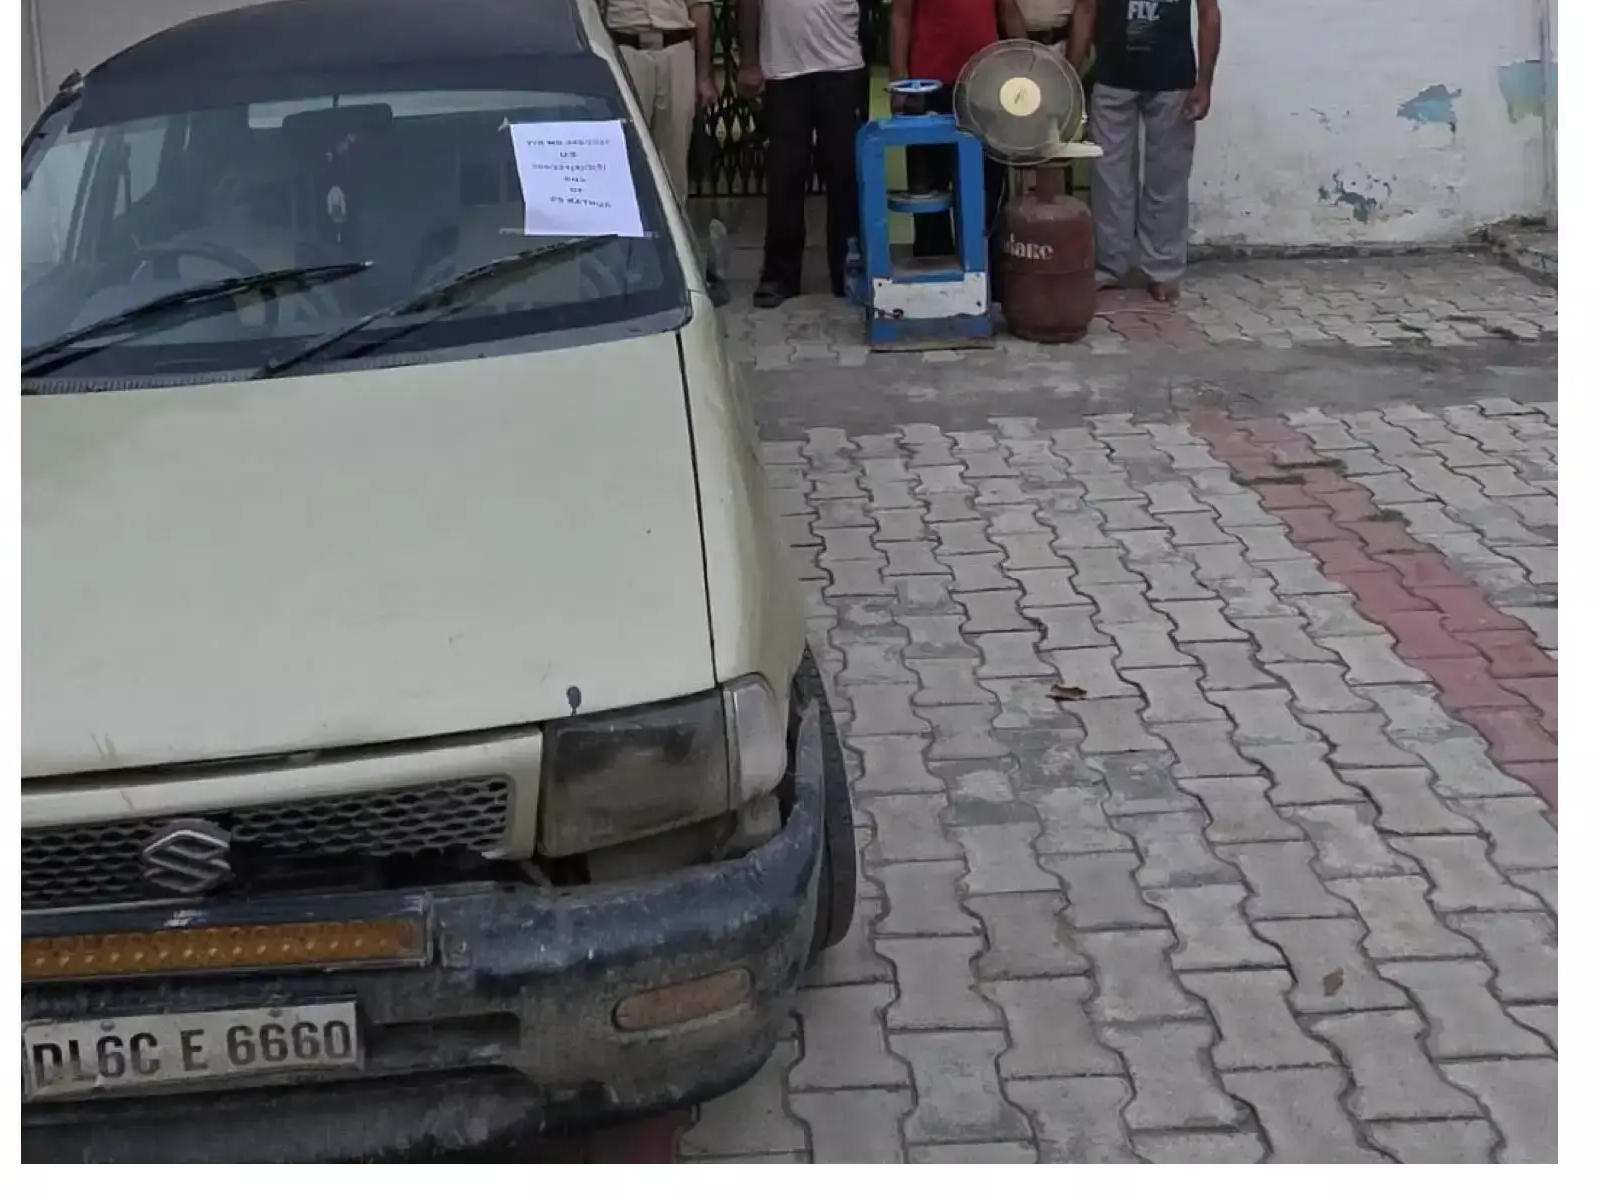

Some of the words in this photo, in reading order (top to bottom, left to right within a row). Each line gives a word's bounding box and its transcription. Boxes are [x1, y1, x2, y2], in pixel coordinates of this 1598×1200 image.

[32, 1033, 161, 1088] DL6C
[180, 1029, 209, 1072] E
[226, 1020, 352, 1067] 6660
